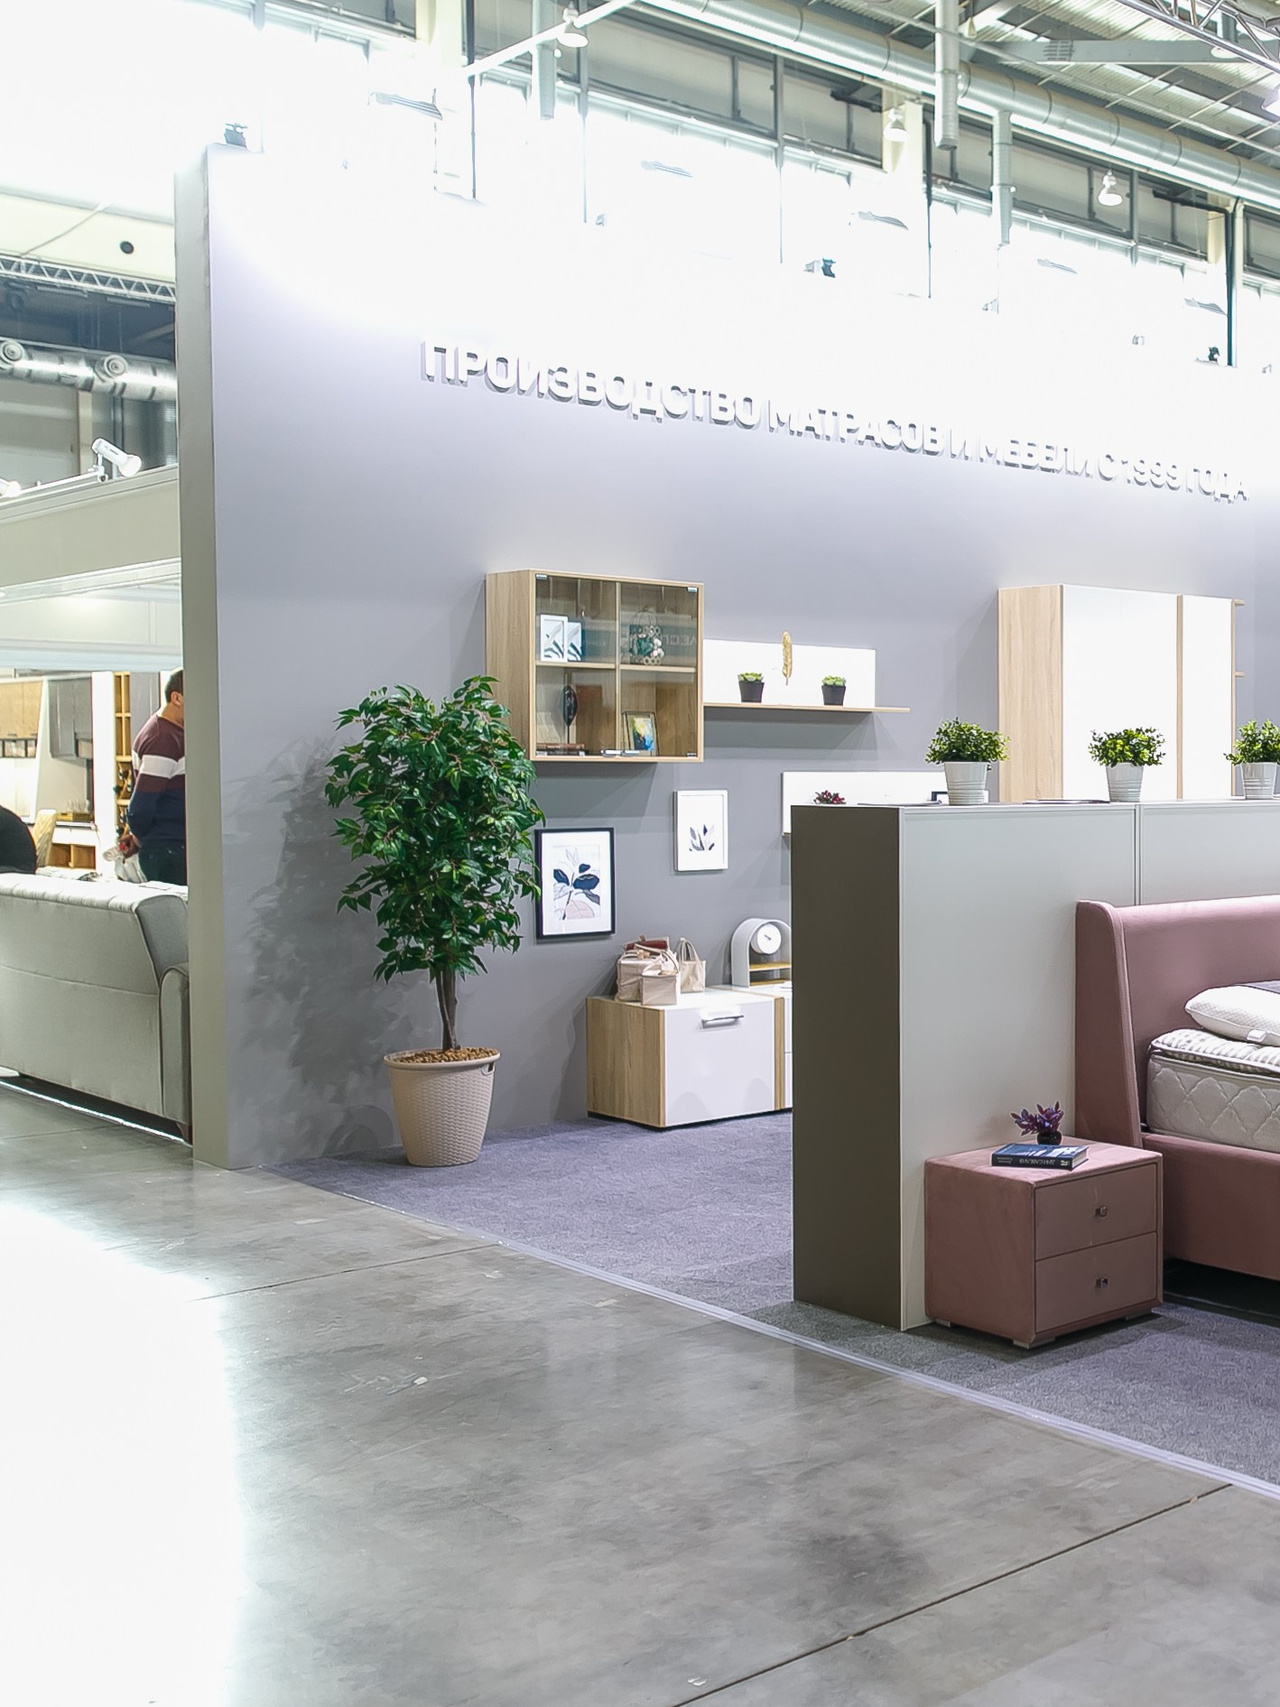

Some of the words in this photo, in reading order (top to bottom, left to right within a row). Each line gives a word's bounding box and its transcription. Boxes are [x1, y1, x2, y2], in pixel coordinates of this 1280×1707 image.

[420, 340, 762, 429] ПРОИЗВОДСТВО
[768, 394, 943, 457] МАТРАСОВ
[949, 426, 972, 462] И
[978, 432, 1093, 479] МЕБЕЛИ
[1098, 451, 1117, 482] С
[1121, 457, 1181, 491] 1999
[1184, 464, 1250, 503] ГОДА
